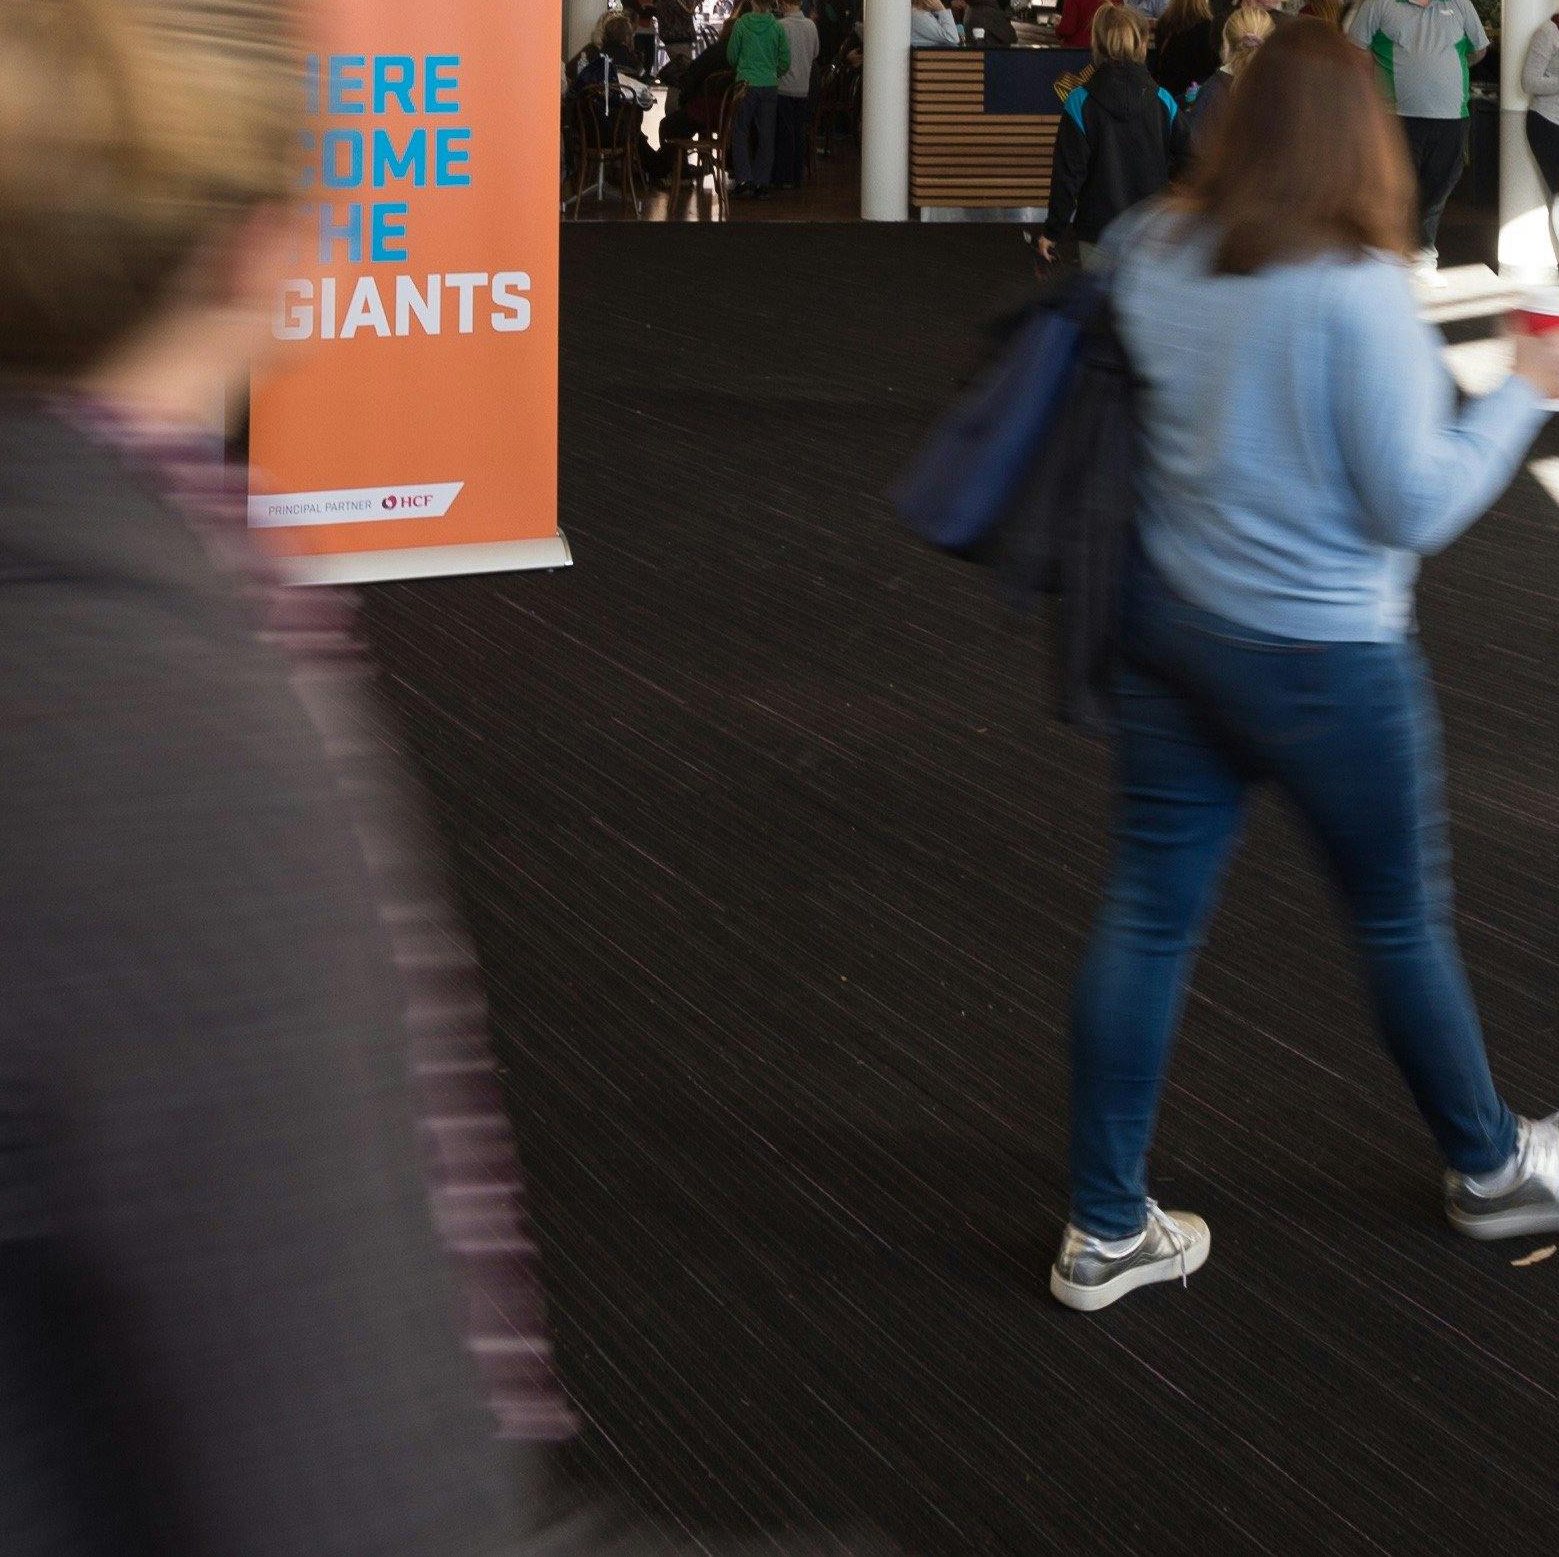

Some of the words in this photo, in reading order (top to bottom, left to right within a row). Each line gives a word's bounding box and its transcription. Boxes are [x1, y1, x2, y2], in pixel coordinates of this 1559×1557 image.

[297, 202, 408, 264] HE
[272, 270, 532, 340] GIANTS
[268, 504, 321, 515] PRINCIPAL
[325, 500, 372, 512] PARTNER
[401, 494, 433, 508] HCF
